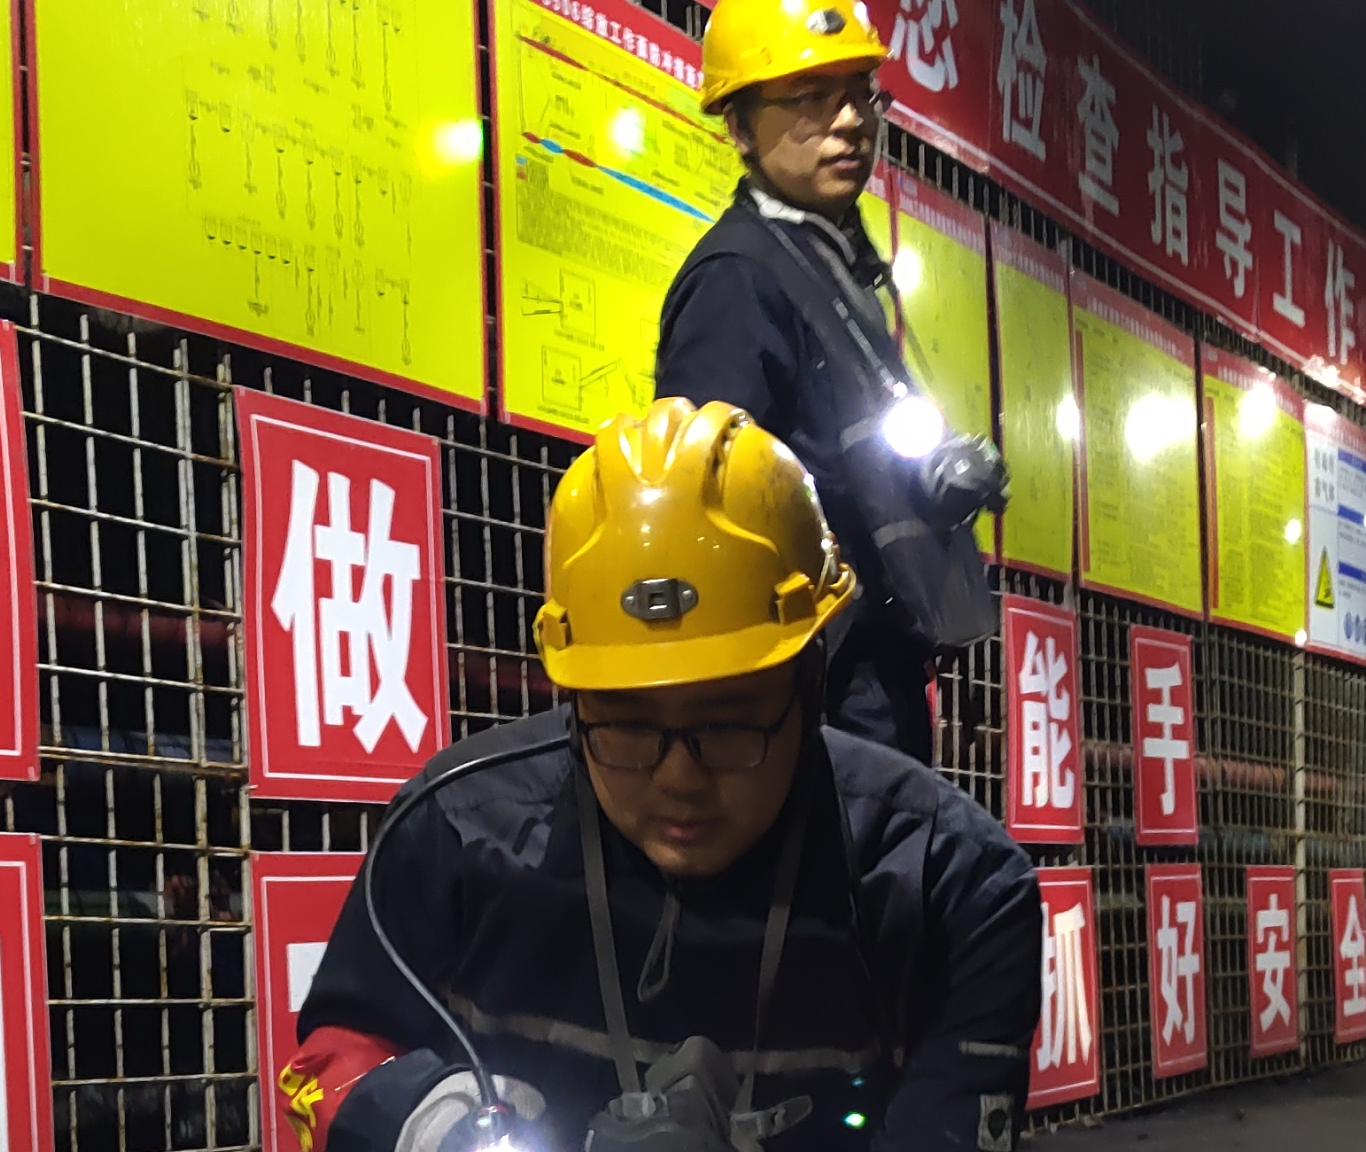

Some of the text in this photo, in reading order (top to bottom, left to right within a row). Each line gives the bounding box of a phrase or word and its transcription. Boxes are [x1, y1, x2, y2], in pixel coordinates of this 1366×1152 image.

[271, 459, 429, 755] 做
[1020, 631, 1075, 809] 能
[1144, 662, 1189, 815] 手
[1036, 901, 1092, 1071] 抓
[1157, 894, 1200, 1046] 好
[1255, 893, 1290, 1032] 安
[1341, 893, 1366, 1015] 全
